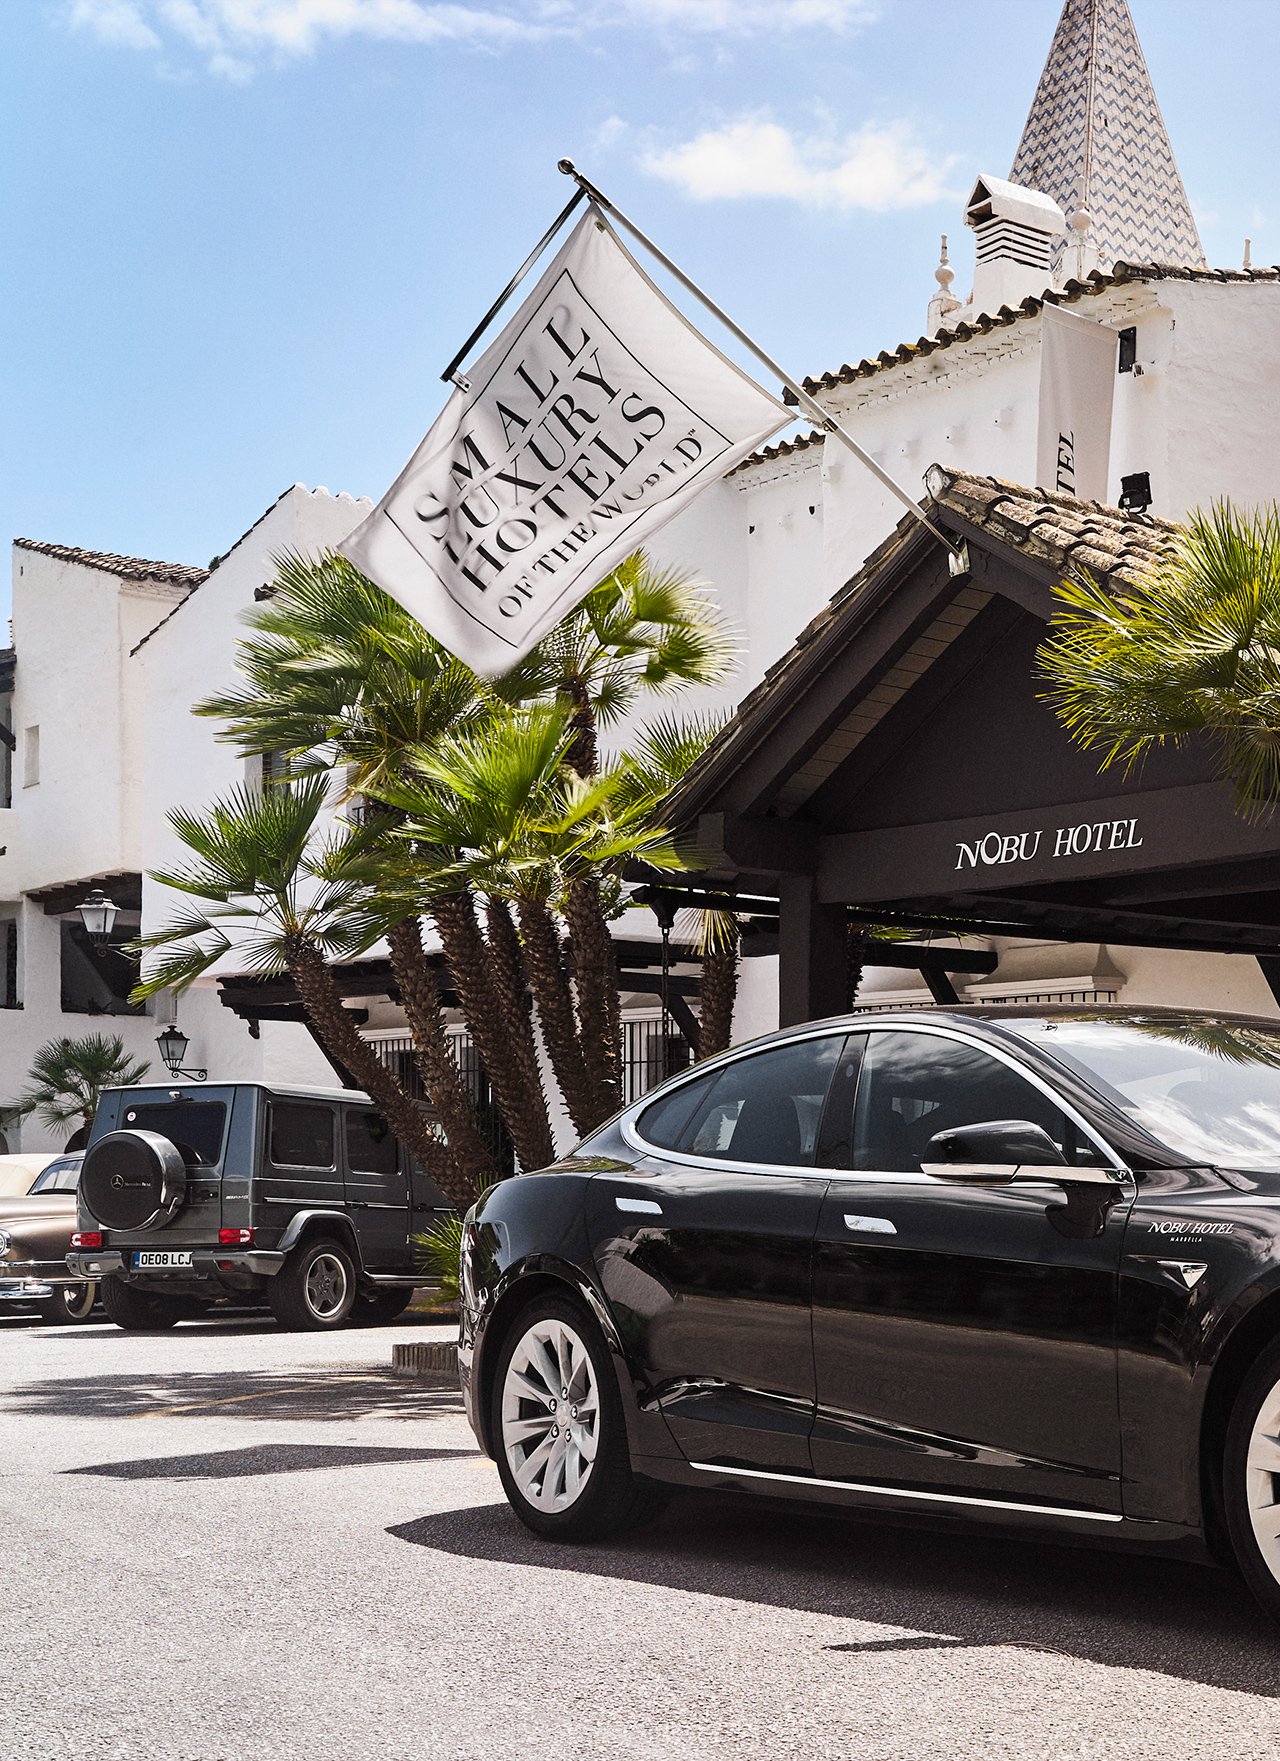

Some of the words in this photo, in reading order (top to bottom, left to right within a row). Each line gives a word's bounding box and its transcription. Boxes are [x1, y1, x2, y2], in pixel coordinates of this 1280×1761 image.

[414, 317, 591, 543] SMALL
[442, 347, 621, 572] LUXURY
[460, 392, 666, 593] HOTELS
[498, 575, 536, 618] OF
[532, 521, 597, 577] THE
[954, 830, 1043, 870] NOBU
[1052, 818, 1144, 857] HOTEL
[141, 1253, 169, 1265] OE08
[1147, 1221, 1191, 1235] NOBU
[1190, 1222, 1235, 1235] HOTEL
